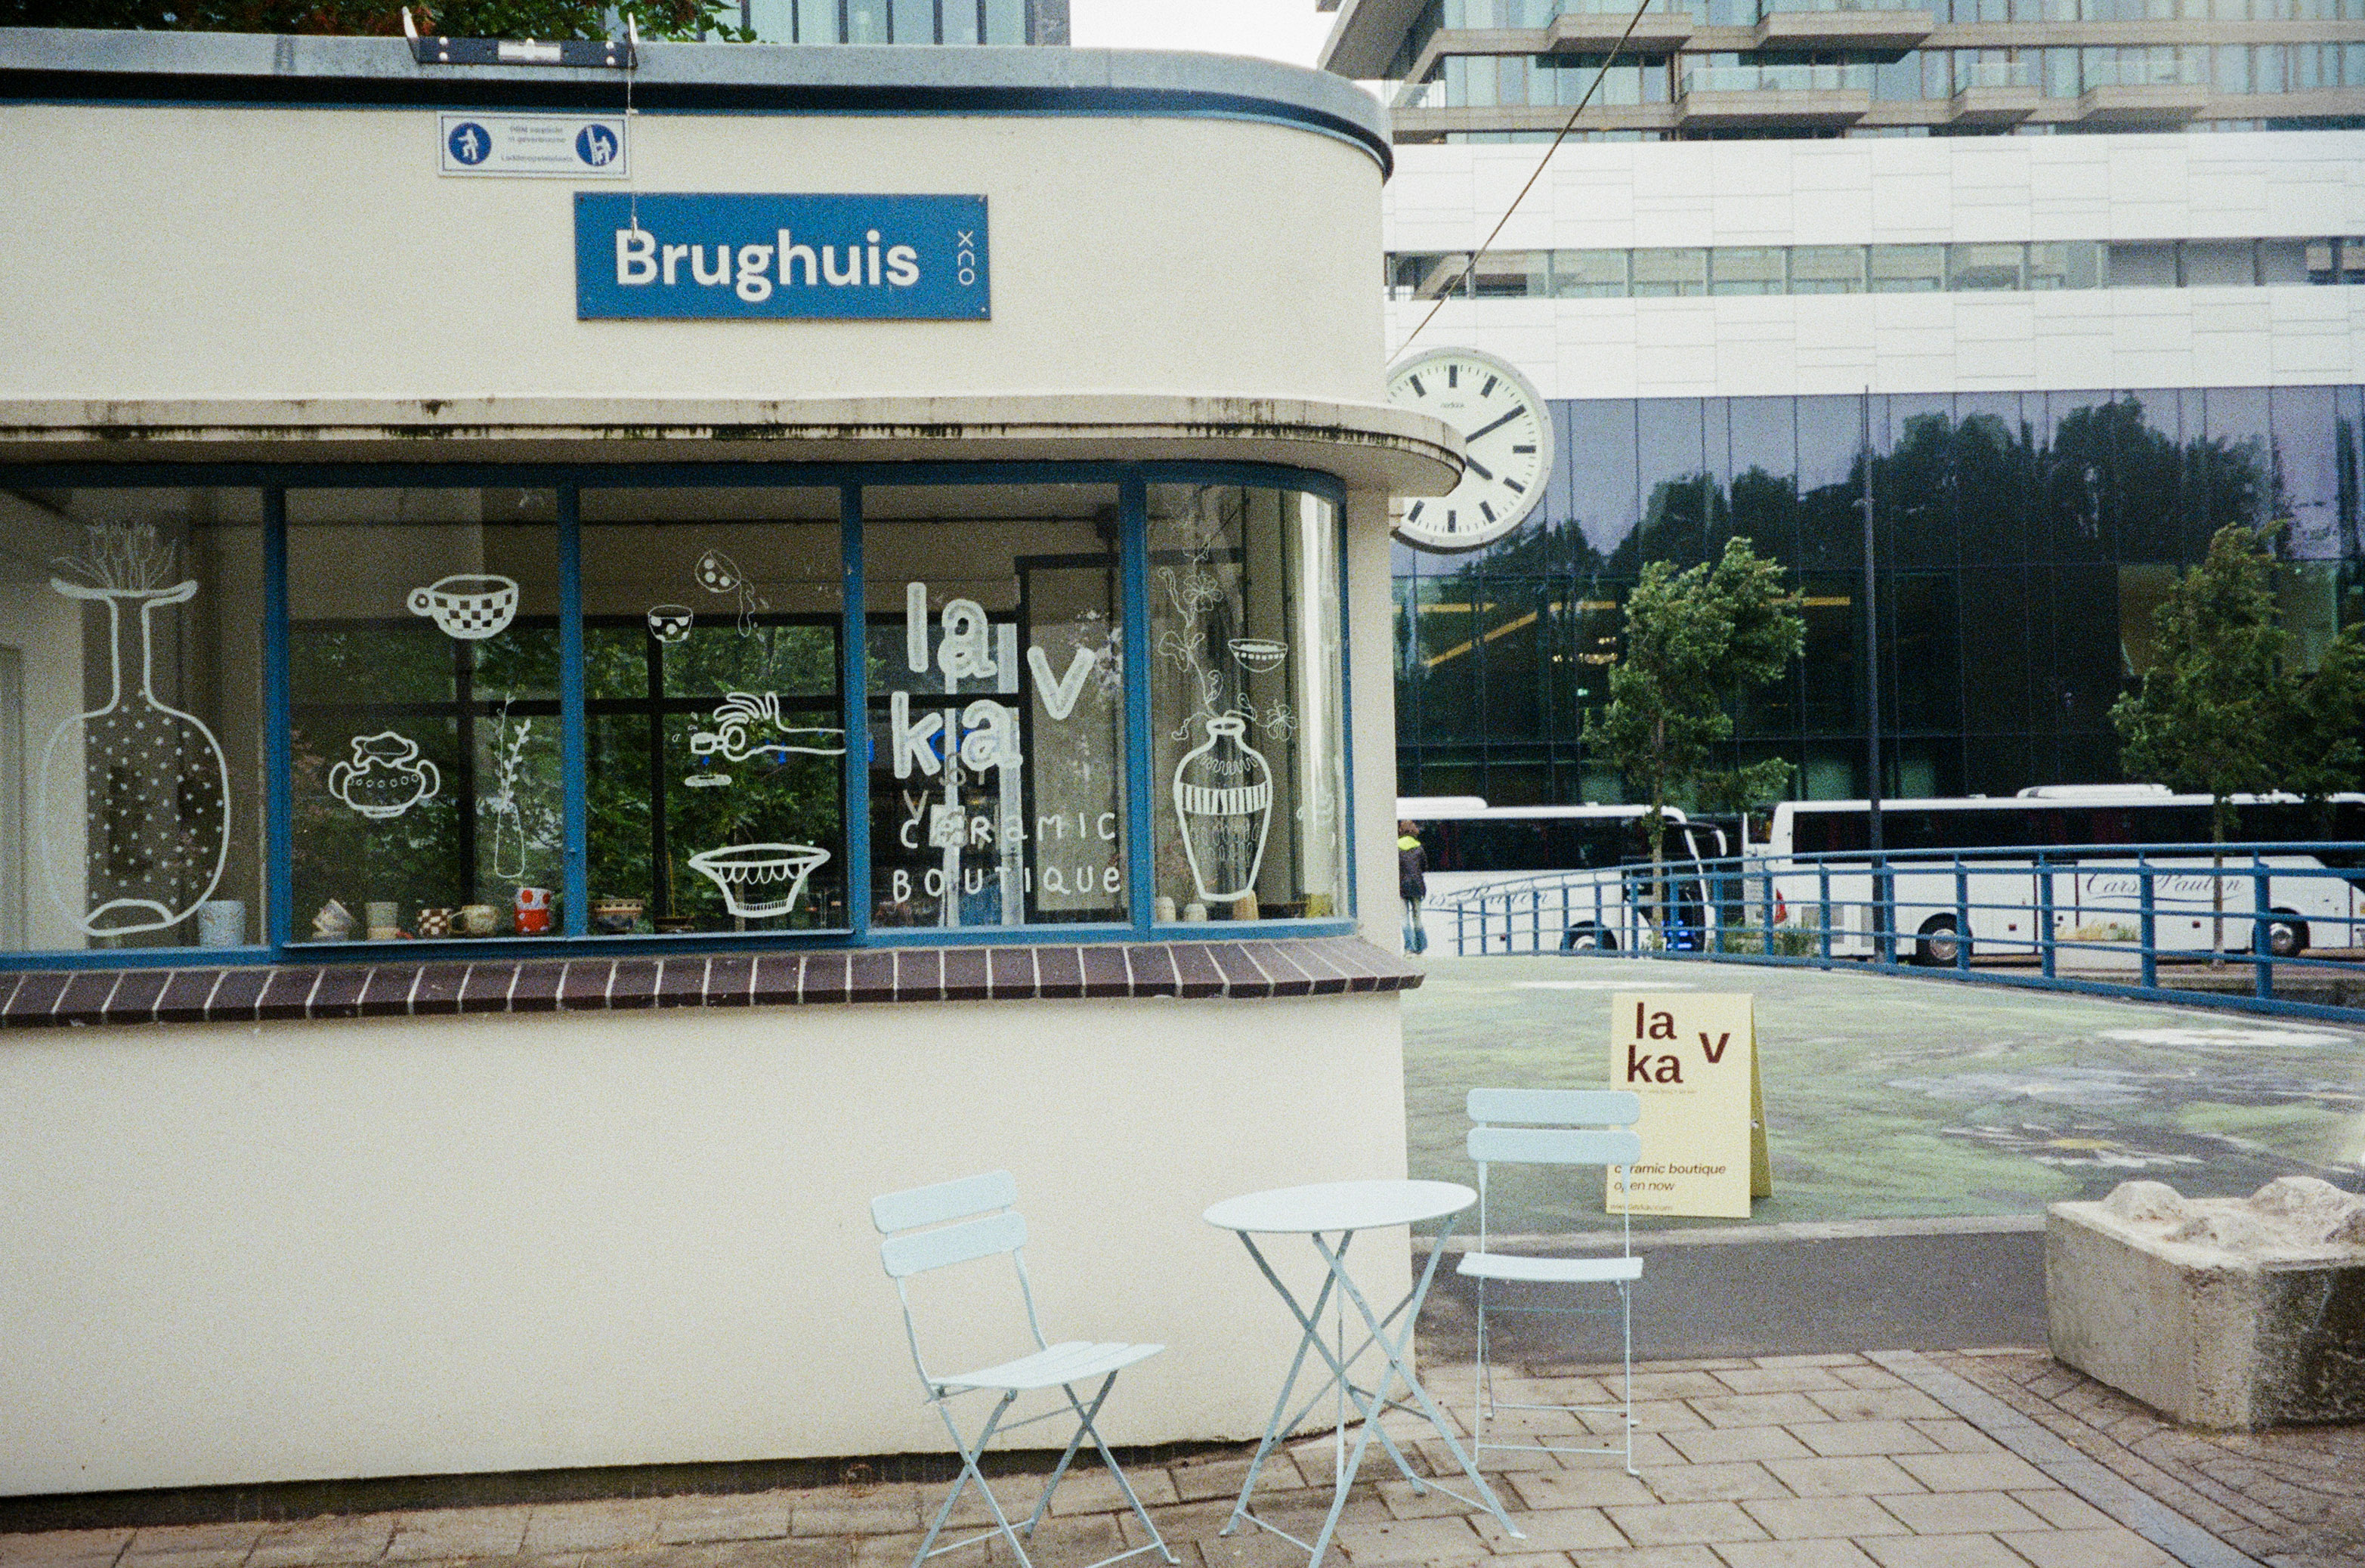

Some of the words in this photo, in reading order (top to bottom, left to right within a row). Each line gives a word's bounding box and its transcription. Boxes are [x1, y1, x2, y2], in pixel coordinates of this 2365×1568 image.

[615, 229, 920, 302] Brughuis
[907, 582, 997, 678] la
[891, 691, 1022, 779] ka
[2155, 873, 2243, 893] Pauln
[1636, 1002, 1677, 1040] la
[1627, 1045, 1683, 1084] ka
[1614, 1163, 1665, 1174] cramic
[1668, 1163, 1727, 1177] boutique
[1648, 1182, 1675, 1191] now
